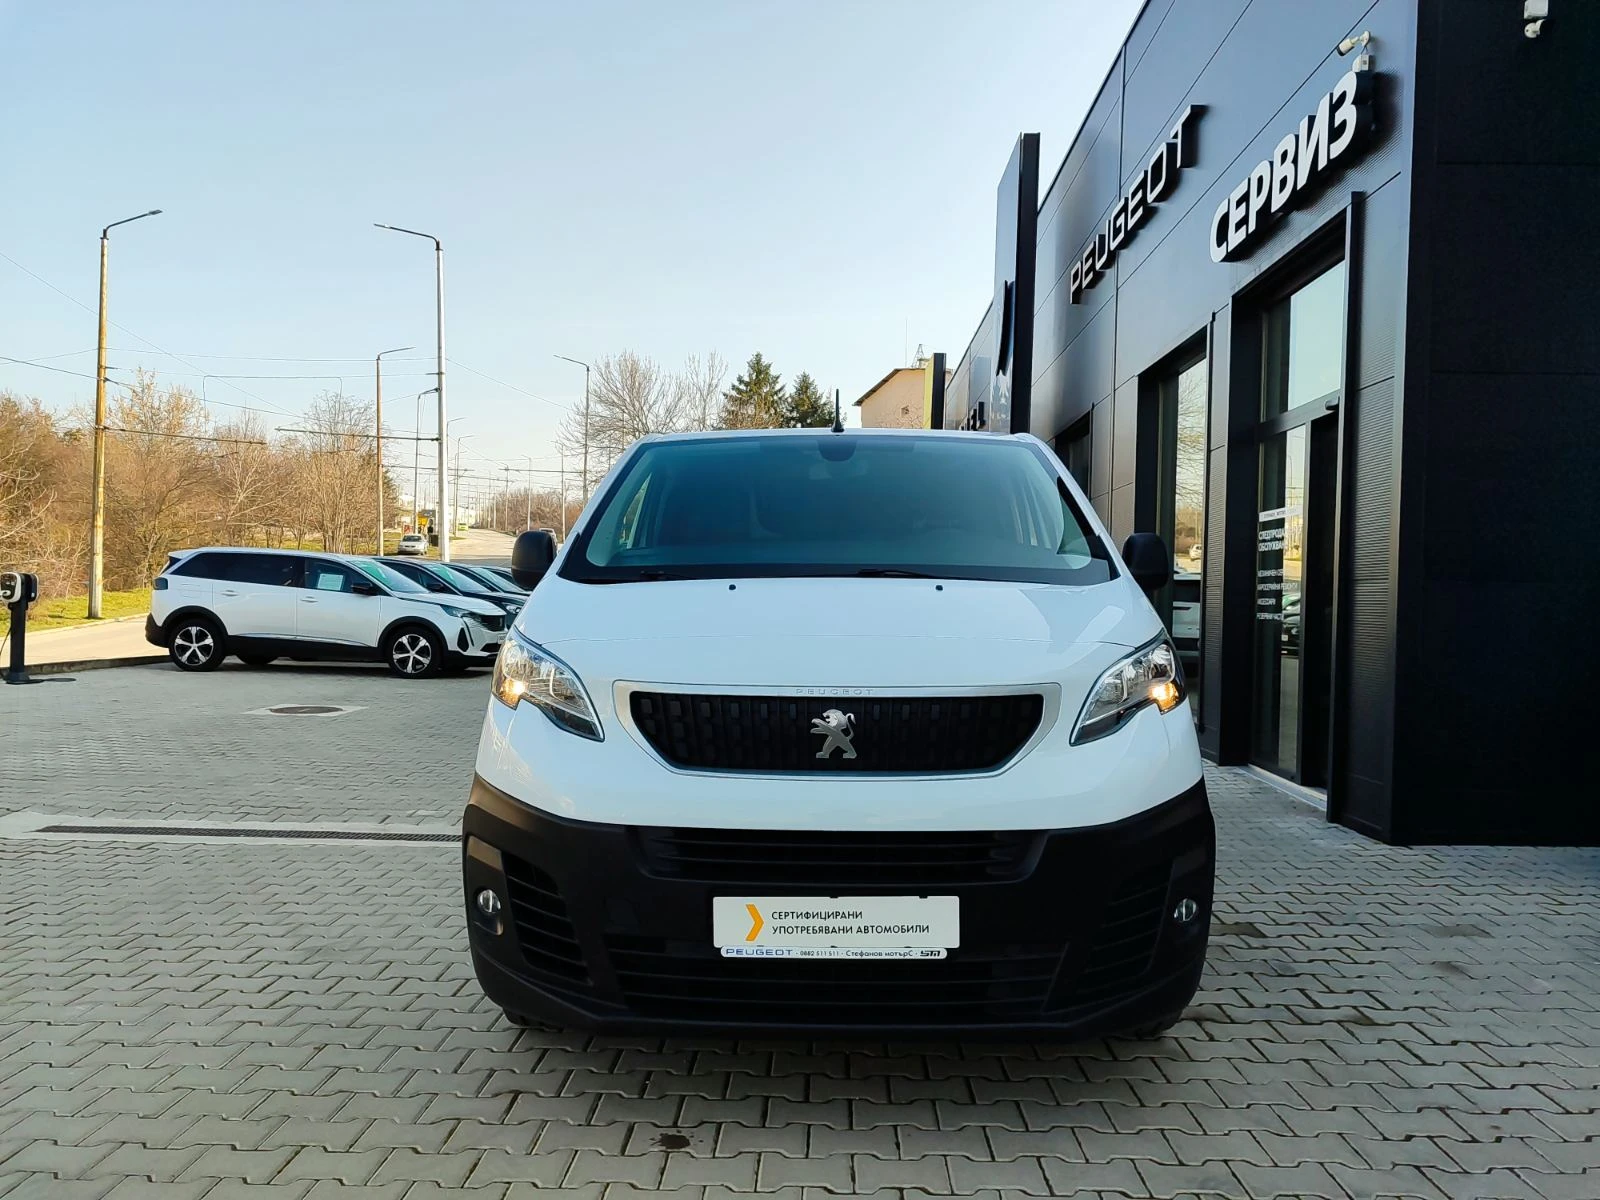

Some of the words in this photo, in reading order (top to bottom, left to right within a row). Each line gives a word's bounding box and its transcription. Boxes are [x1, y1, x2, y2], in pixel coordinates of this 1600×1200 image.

[1210, 71, 1359, 263] СЕРВИЗ
[1070, 104, 1198, 304] PEUGEOT
[796, 688, 874, 696] PEUGEOT
[771, 911, 863, 921] СЕРТИФИЦИРАНИ
[772, 925, 853, 935] УПОТРЕБЯВАНИ
[856, 924, 930, 934] АВТОМОБИЛИ
[725, 948, 793, 956] PEUGEOT
[845, 950, 882, 958] Стефанов
